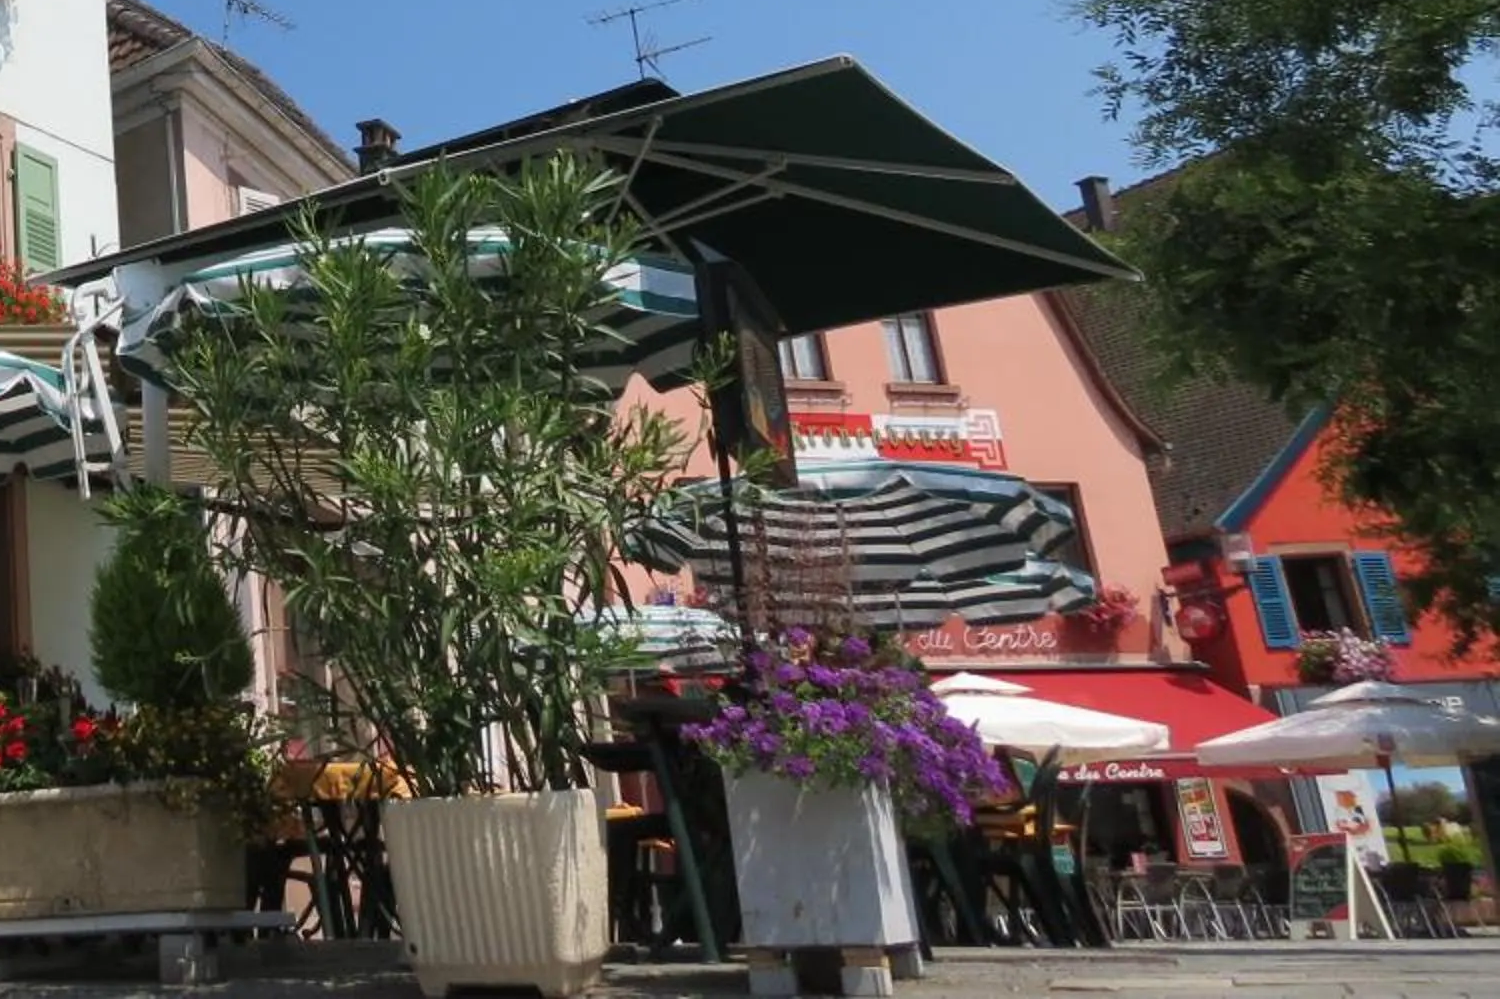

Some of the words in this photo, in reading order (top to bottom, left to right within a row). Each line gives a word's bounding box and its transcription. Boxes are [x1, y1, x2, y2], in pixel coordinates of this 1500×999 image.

[963, 622, 1058, 650] Centre
[1074, 762, 1100, 781] du
[1104, 761, 1165, 780] Centre
